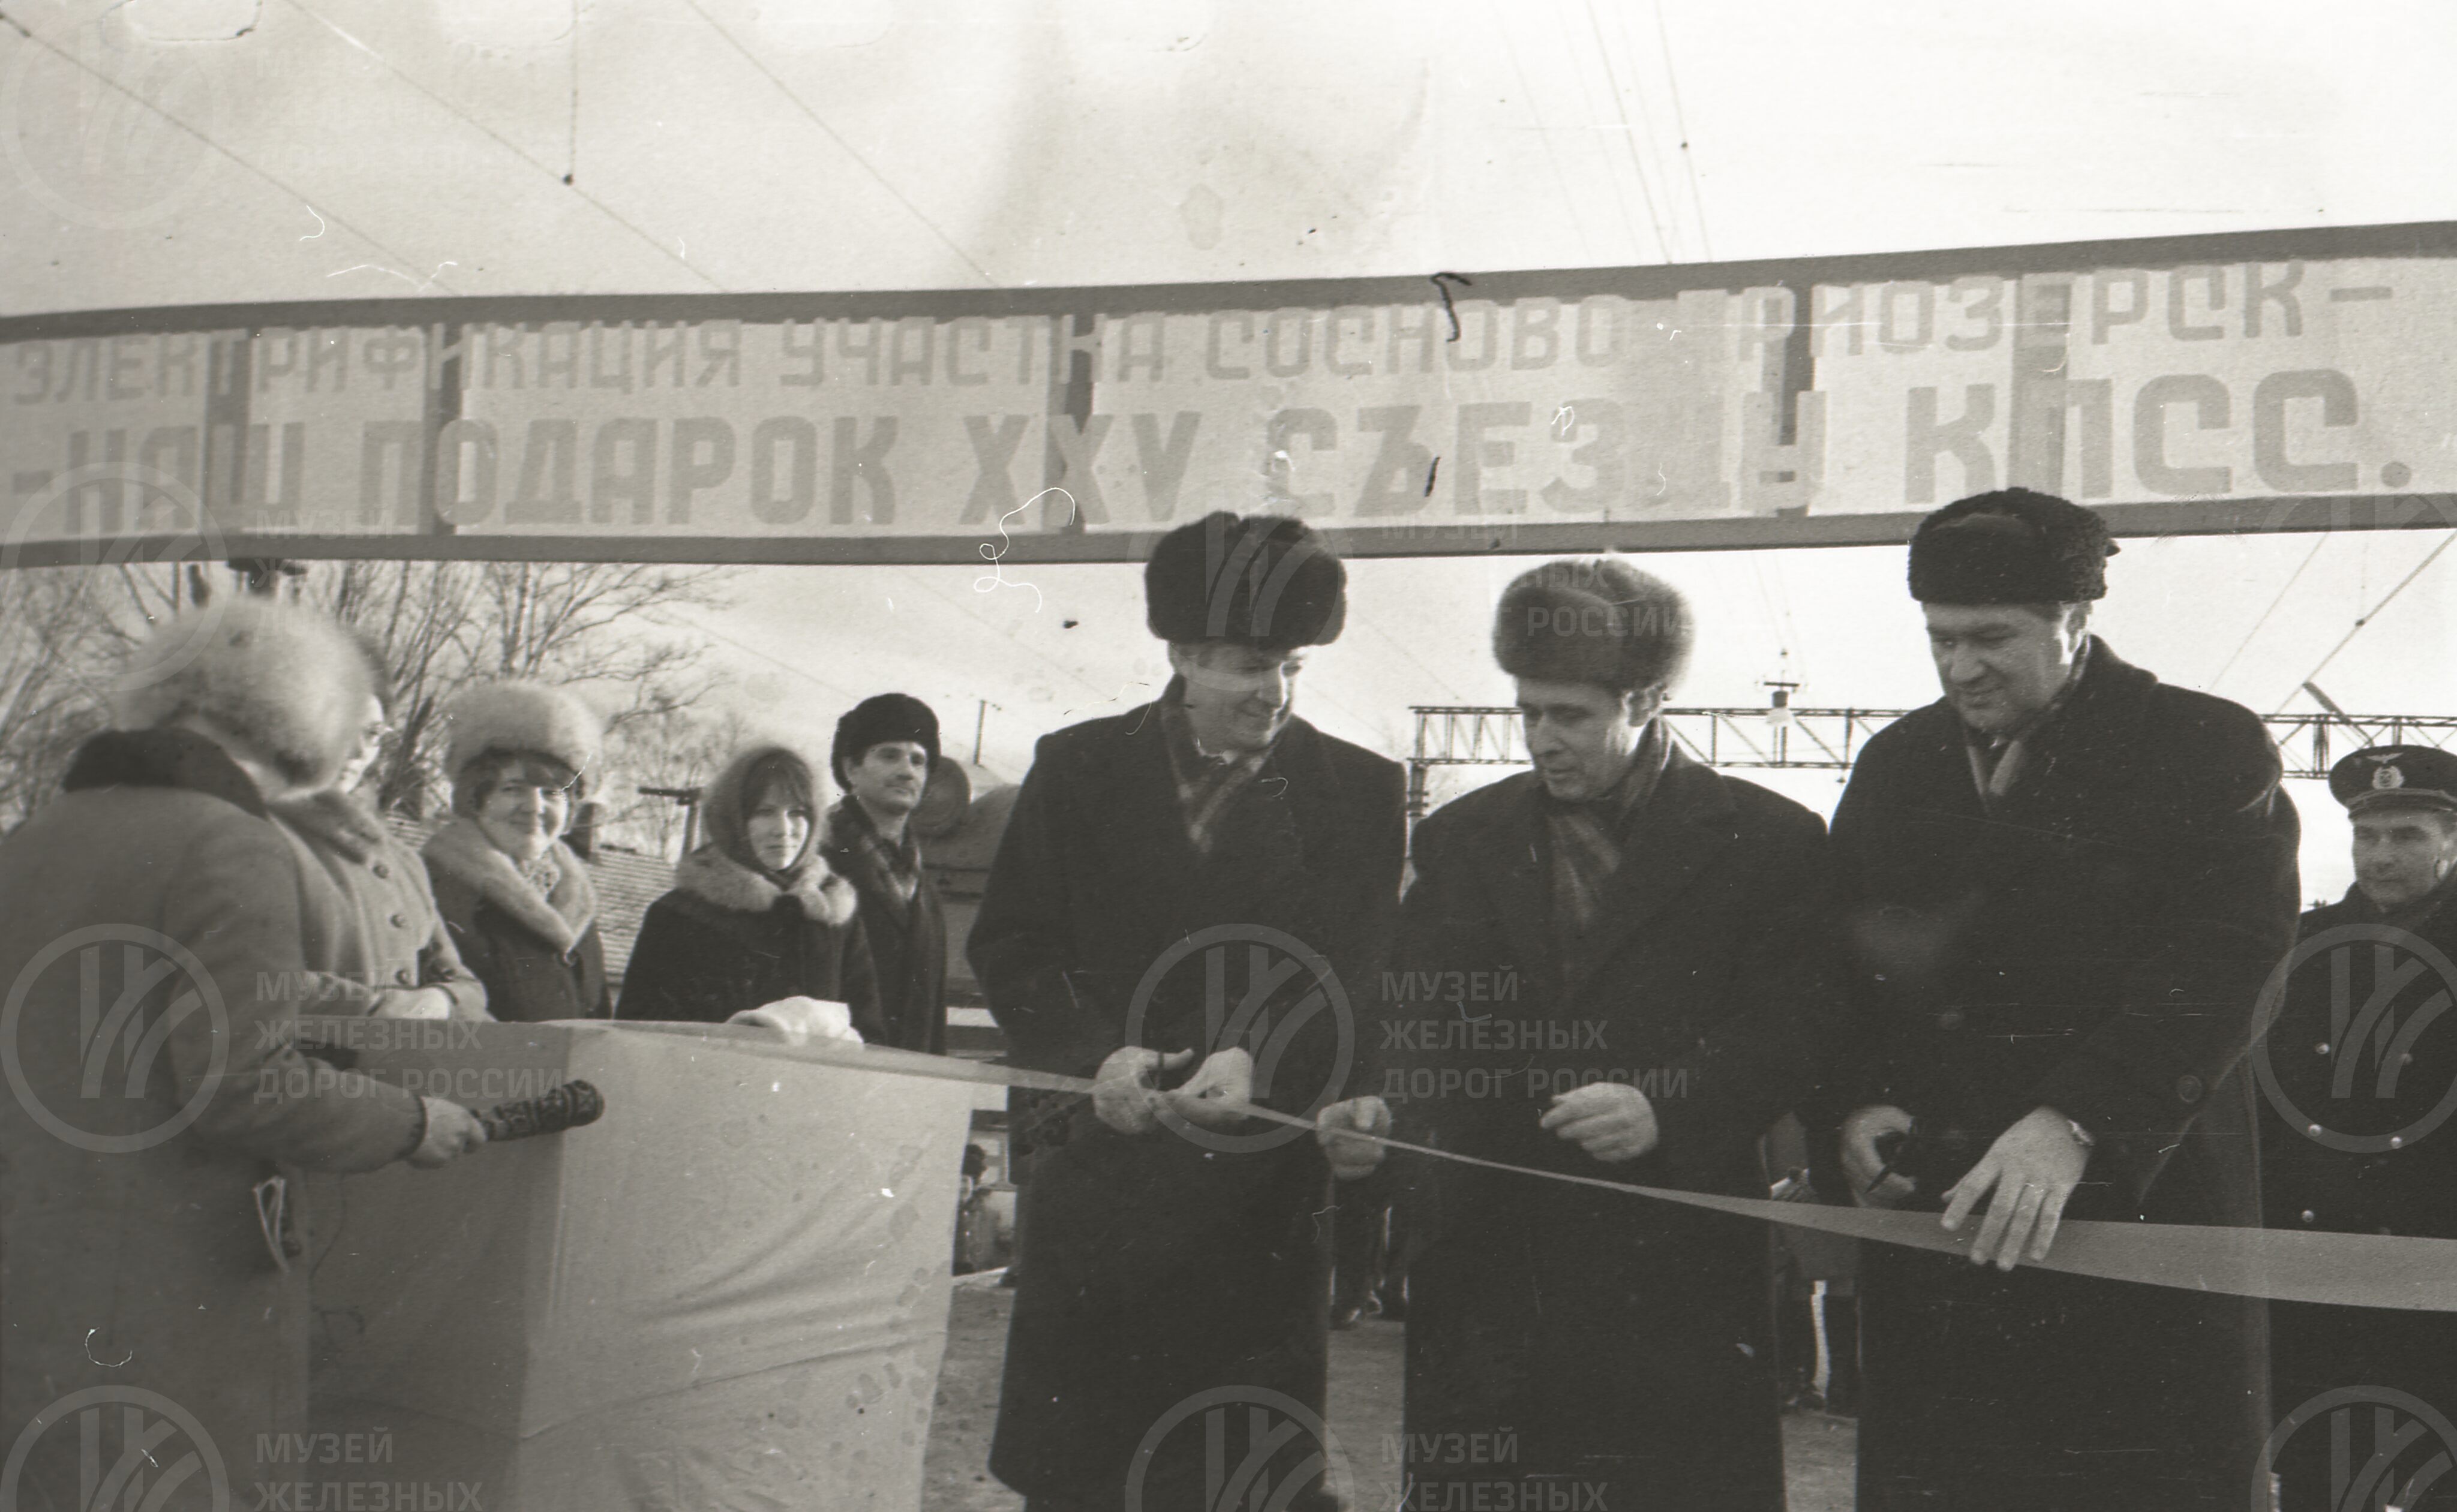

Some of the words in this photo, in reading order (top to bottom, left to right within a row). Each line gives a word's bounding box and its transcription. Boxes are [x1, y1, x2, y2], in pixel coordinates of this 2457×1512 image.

[13, 320, 741, 405] ЭЛЕКТРИФИКАЦИЯ
[779, 311, 1166, 387] УЧАСТКА
[1205, 294, 1629, 380] СОСНОВО
[362, 415, 899, 525] ПОДАРОК
